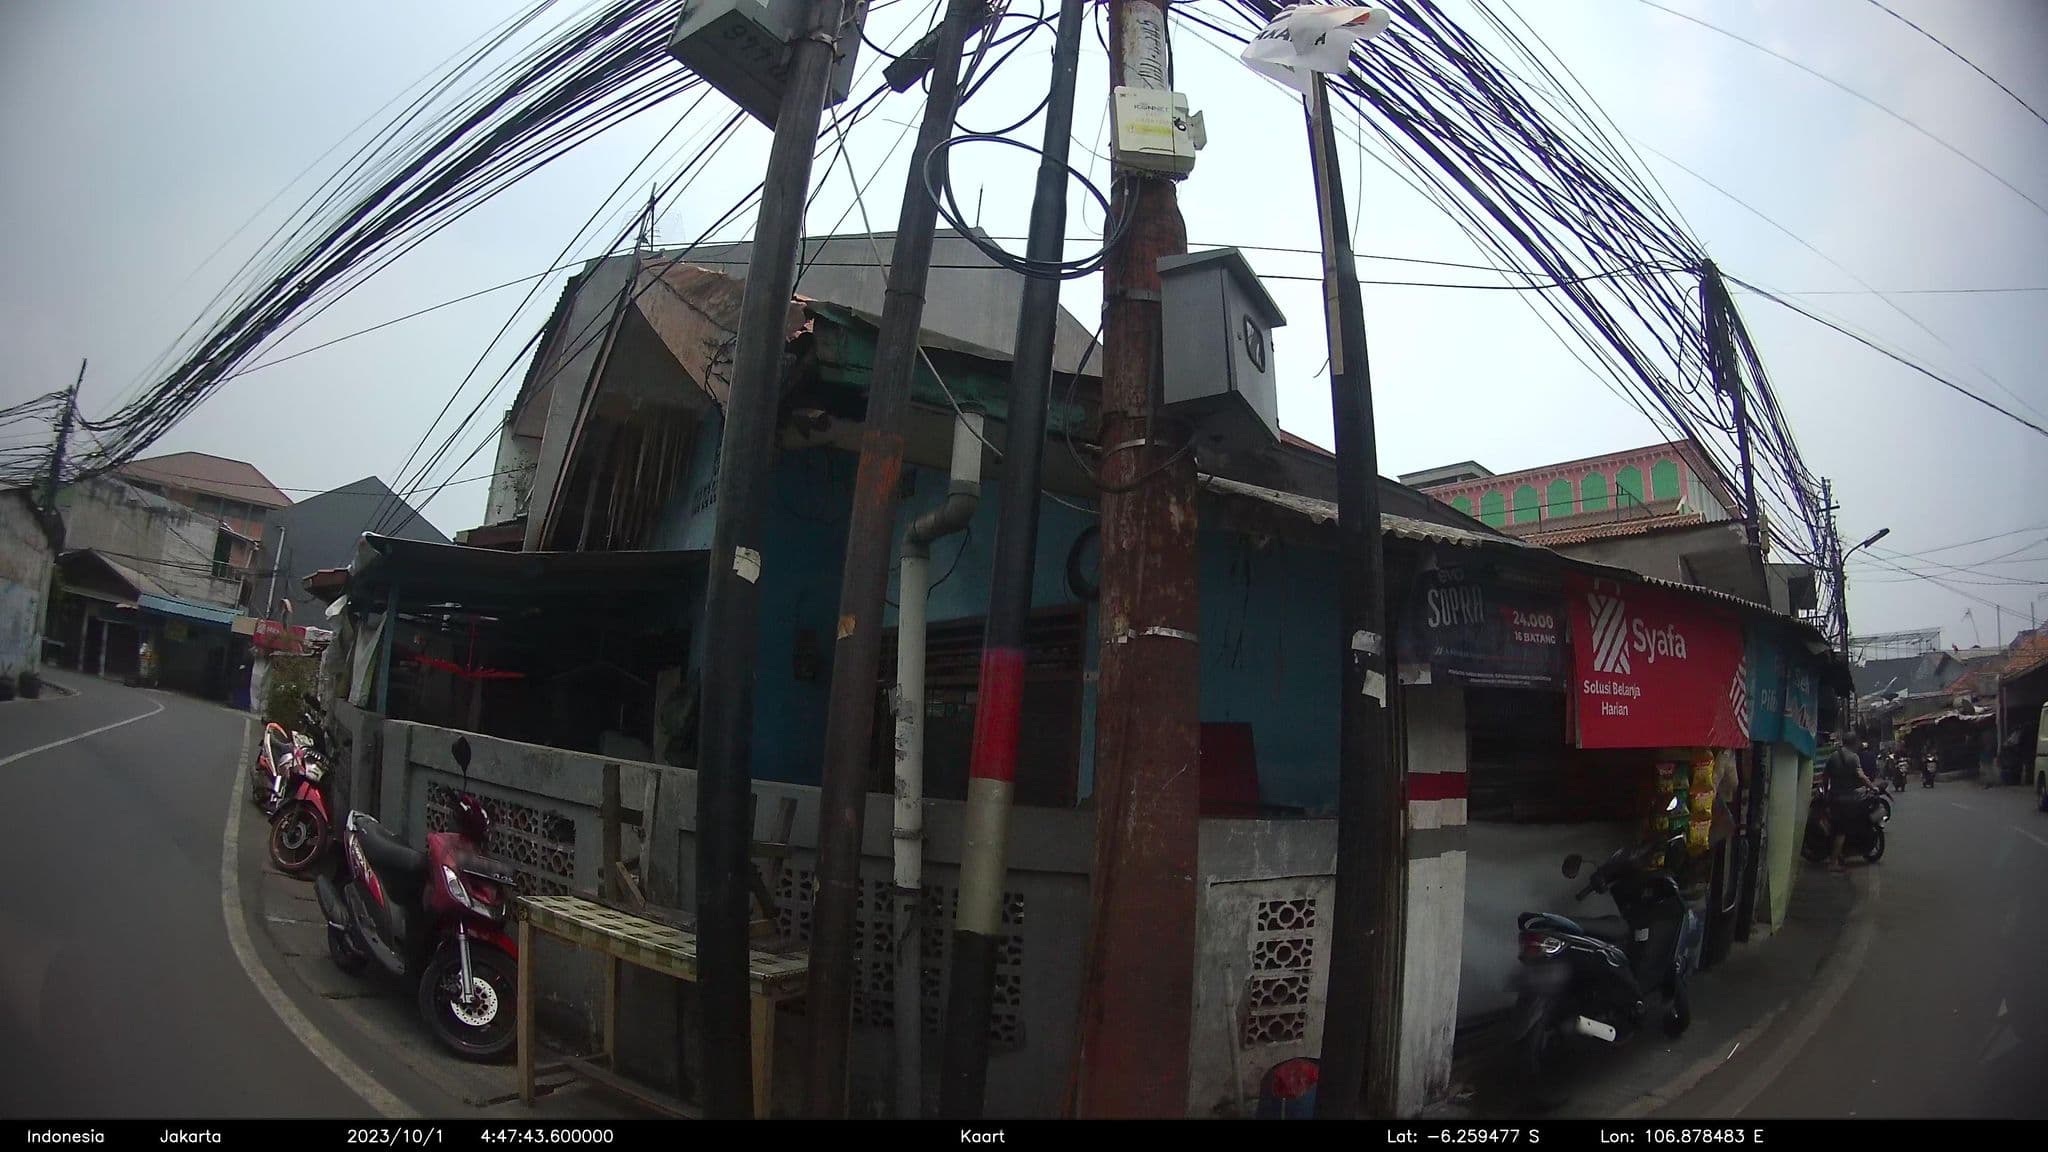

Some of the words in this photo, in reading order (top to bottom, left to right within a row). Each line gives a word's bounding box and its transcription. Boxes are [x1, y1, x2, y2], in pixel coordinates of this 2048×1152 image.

[1512, 610, 1554, 629] 24.000
[1514, 630, 1524, 642] 16
[1523, 632, 1557, 645] BATANG
[1632, 618, 1688, 664] Syafa
[1583, 680, 1612, 696] Solusi
[1613, 681, 1641, 699] Belanja
[1602, 701, 1629, 717] Harian
